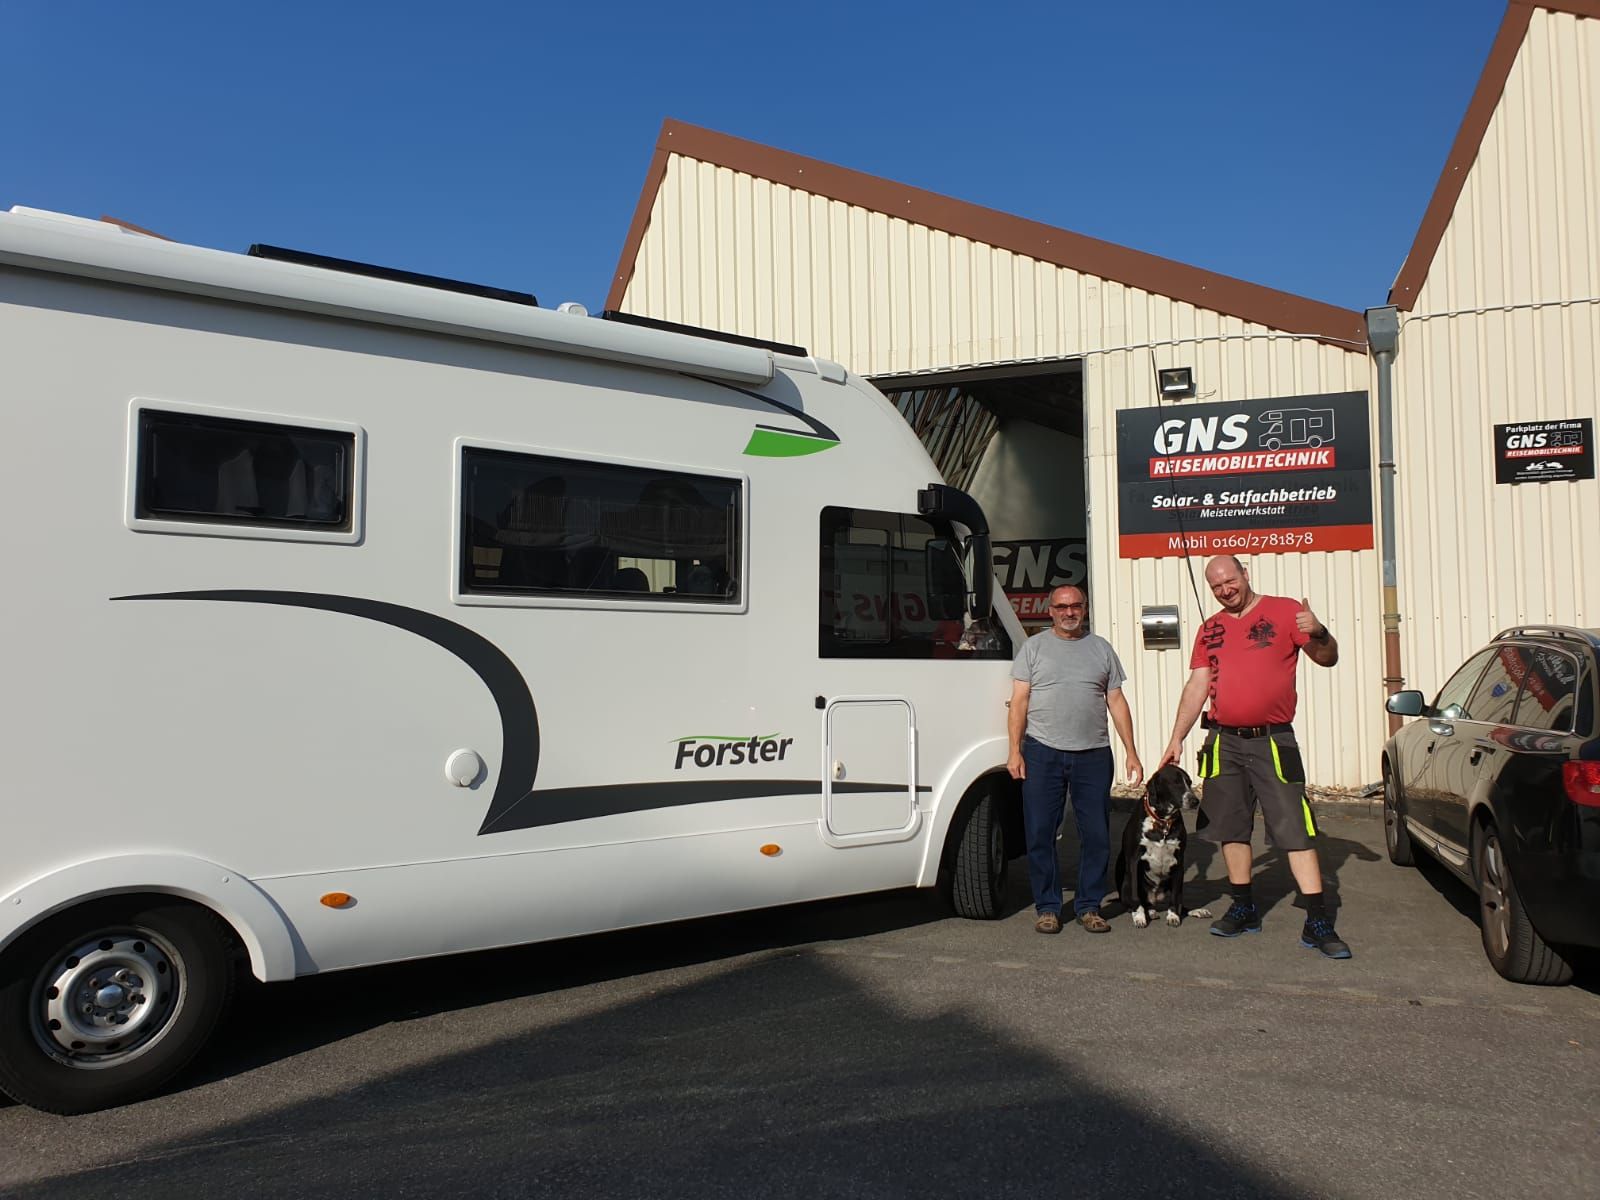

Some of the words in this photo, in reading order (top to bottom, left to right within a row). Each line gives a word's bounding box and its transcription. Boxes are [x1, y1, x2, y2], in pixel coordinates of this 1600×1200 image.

[1153, 414, 1250, 455] GNS
[1505, 425, 1543, 433] Parkplatz
[1559, 422, 1582, 430] Firma
[1506, 433, 1548, 449] GNS
[1507, 446, 1581, 457] REISEMOBILTECHNIK
[1154, 451, 1330, 475] REISEMOBILTECHNIK
[1152, 494, 1198, 508] Solar-
[1203, 493, 1215, 506] &
[1219, 486, 1336, 507] Satfachbetrieb
[1200, 505, 1285, 519] Meisterwerkstatt
[1168, 534, 1207, 549] Mobil
[1213, 532, 1313, 549] 0160/2781878
[674, 735, 793, 769] Forster
